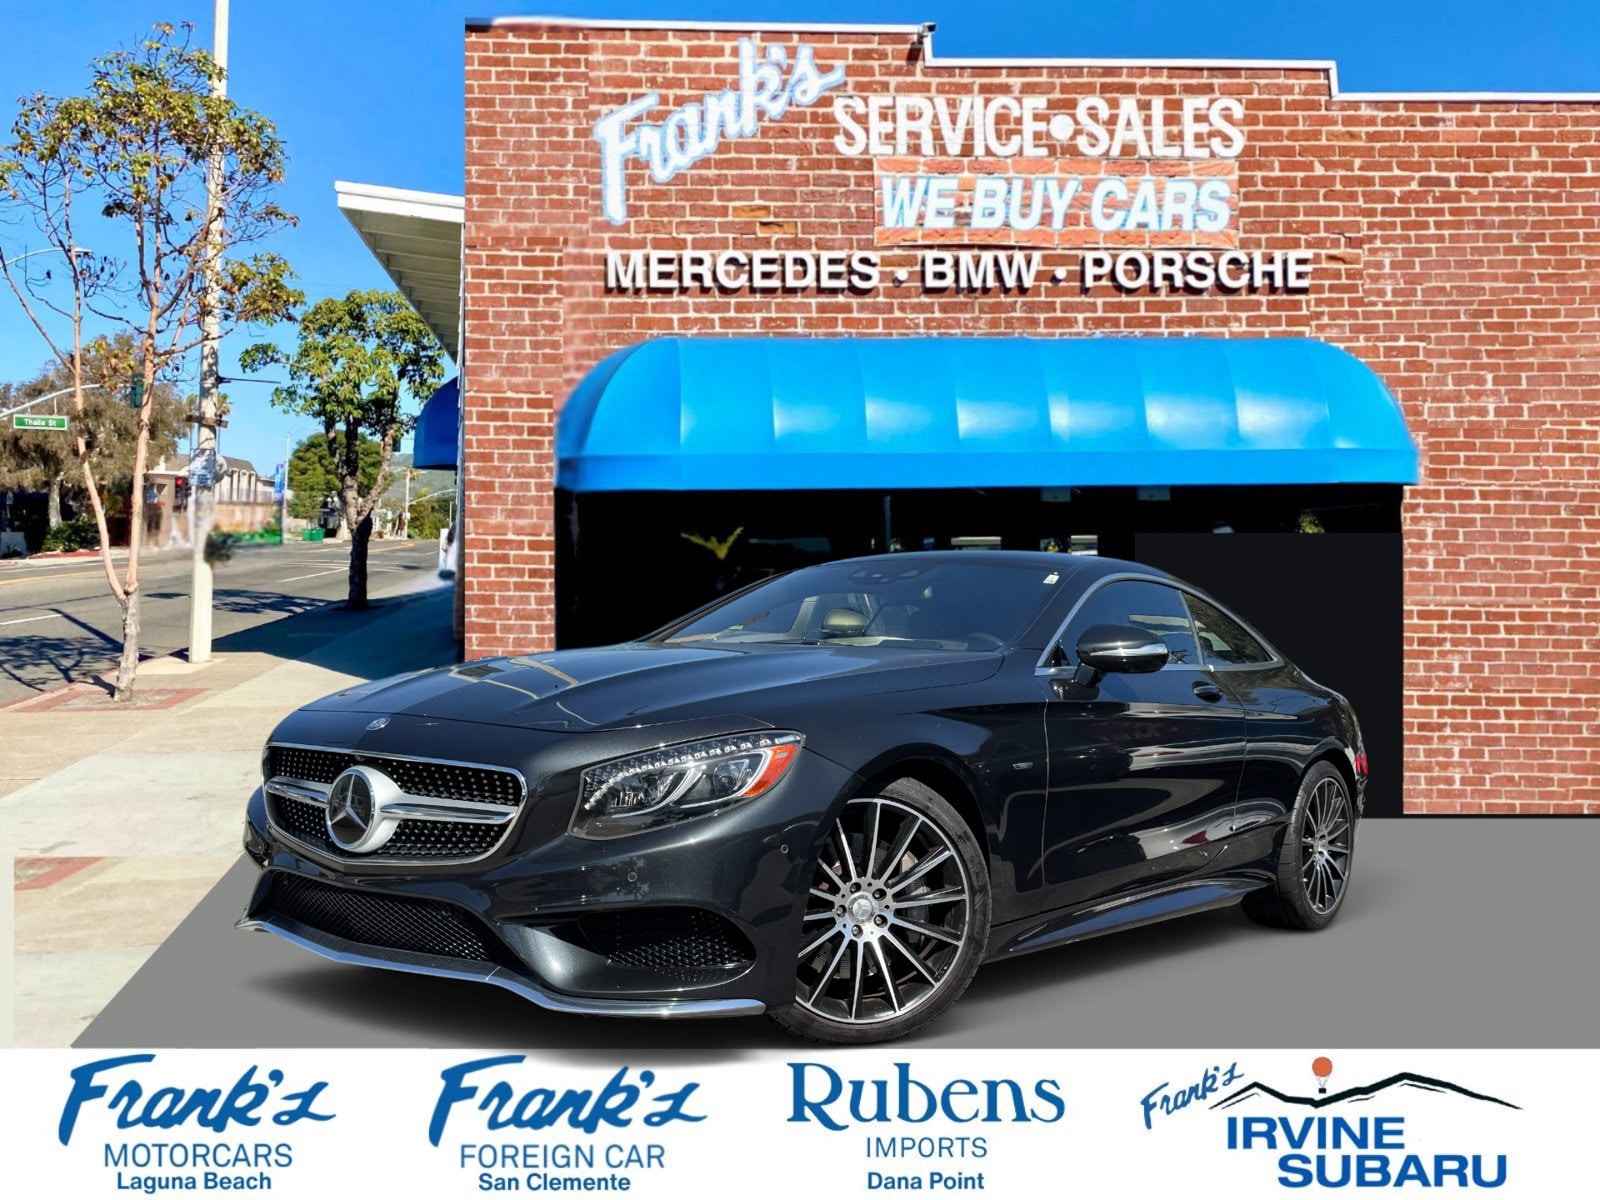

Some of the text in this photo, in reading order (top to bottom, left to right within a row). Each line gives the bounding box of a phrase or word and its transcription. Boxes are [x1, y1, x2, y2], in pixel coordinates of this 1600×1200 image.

[594, 37, 846, 225] Frank's
[833, 95, 1245, 158] SERVICE SALES
[880, 174, 1233, 233] WE BUY CARS
[606, 250, 1313, 289] MERCEDES BMW PORSCHE
[48, 419, 56, 427] St
